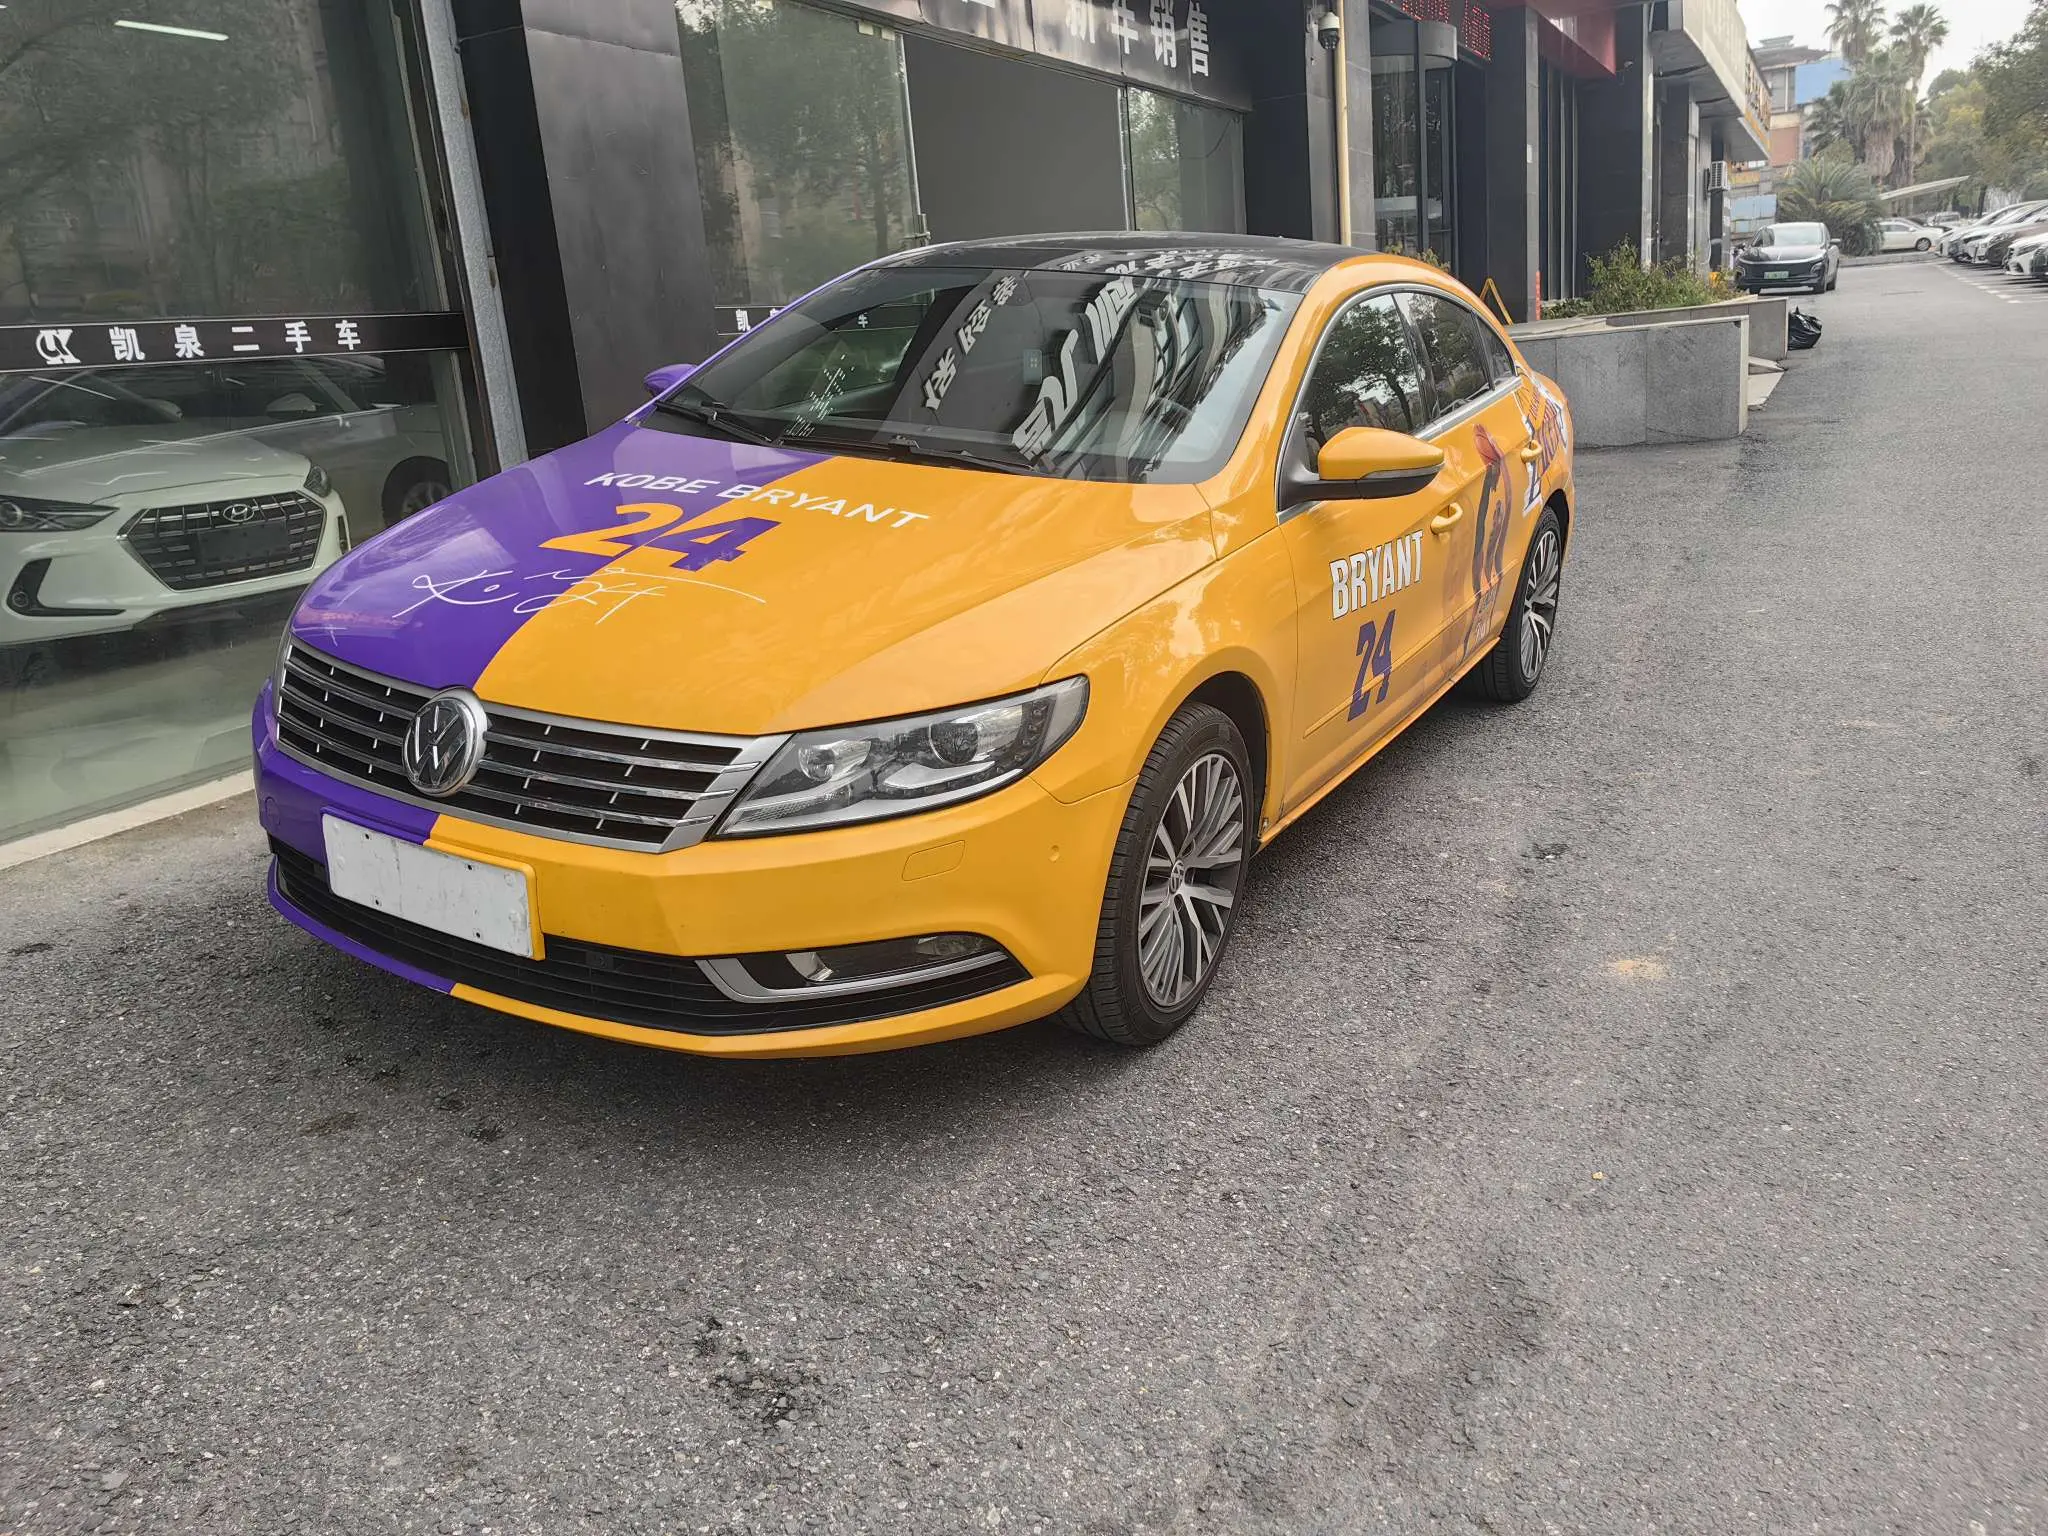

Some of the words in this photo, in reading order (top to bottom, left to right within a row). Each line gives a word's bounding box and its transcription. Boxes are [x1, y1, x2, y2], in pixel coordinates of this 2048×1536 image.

[109, 320, 361, 361] 凯泉二手车
[584, 472, 719, 496] KOBE
[719, 483, 930, 529] BRYANT
[538, 502, 782, 573] 24
[1329, 529, 1424, 620] BRYANT
[1348, 609, 1396, 721] 24
